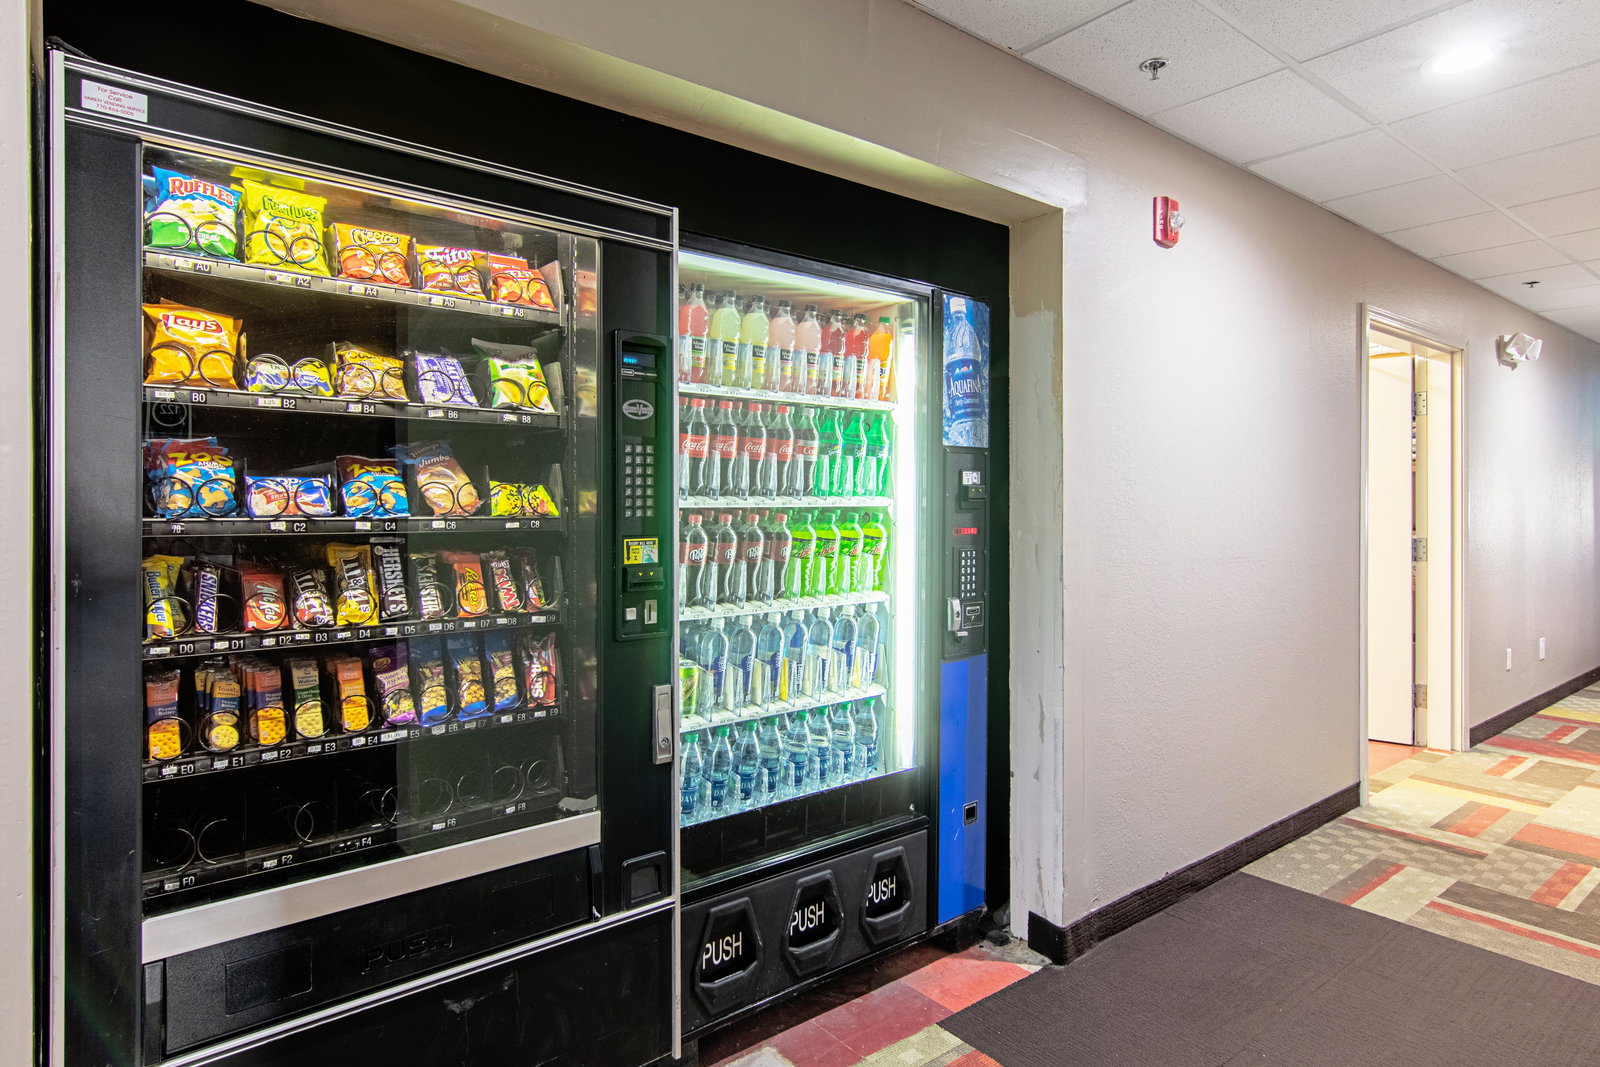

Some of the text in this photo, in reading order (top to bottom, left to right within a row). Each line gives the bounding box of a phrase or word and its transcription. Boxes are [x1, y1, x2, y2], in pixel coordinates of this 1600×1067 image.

[109, 89, 133, 100] Service
[103, 100, 126, 109] VENDING
[169, 176, 235, 206] RUFFLES
[296, 277, 310, 287] A2
[366, 287, 377, 297] A4
[444, 298, 455, 307] A6
[950, 374, 982, 398] AQUAFINA
[192, 392, 206, 403] B0
[283, 399, 296, 409] B2
[363, 404, 375, 414] B4
[448, 410, 459, 419] B6
[167, 452, 234, 467] ZOO
[418, 453, 450, 468] Jumbo
[346, 464, 399, 478] ZOO
[293, 522, 307, 533] C2
[384, 522, 397, 531] C4
[445, 521, 457, 530] C6
[530, 520, 541, 529] C8
[496, 568, 520, 611] TWIX
[197, 571, 218, 633] SNICKERS
[258, 599, 281, 621] Kat
[507, 617, 517, 625] D8
[546, 615, 556, 623] D9
[444, 622, 454, 631] D6
[480, 620, 490, 628] D7
[359, 630, 371, 639] D4
[404, 626, 416, 634] D5
[279, 636, 292, 646] D2
[315, 633, 328, 642] D3
[179, 644, 194, 653] D0
[231, 640, 244, 649] D1
[217, 686, 240, 694] Toasty
[550, 708, 559, 716] E9
[517, 713, 526, 721] E8
[448, 724, 458, 732] E6
[477, 719, 486, 728] E7
[410, 730, 420, 738] E5
[367, 736, 378, 745] E4
[324, 743, 336, 752] E3
[280, 749, 292, 759] E2
[232, 756, 244, 767] E1
[180, 764, 194, 774] E0
[517, 803, 526, 811] F8
[447, 819, 457, 828] F6
[361, 836, 372, 847] F4
[281, 855, 293, 866] F2
[182, 875, 195, 888] F0
[866, 875, 896, 907] PUSH
[790, 901, 825, 936] PUSH
[702, 931, 742, 970] PUSH
